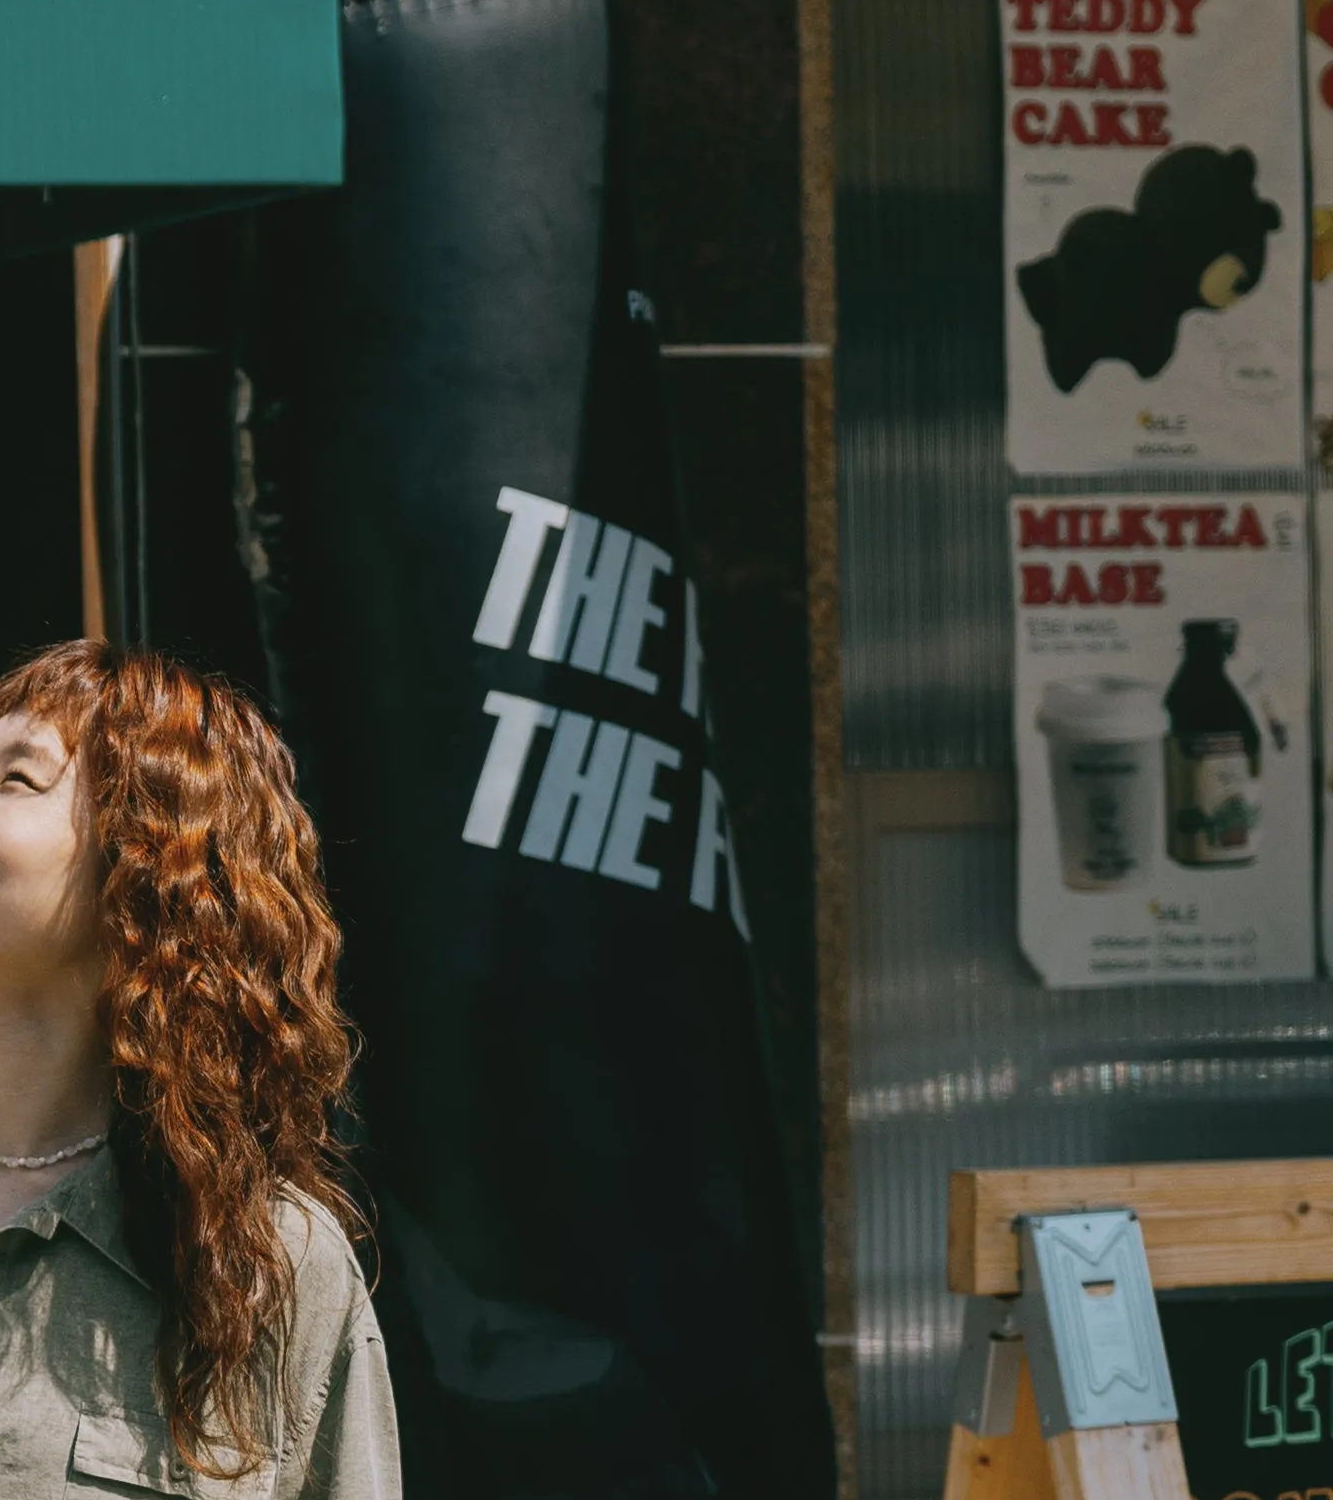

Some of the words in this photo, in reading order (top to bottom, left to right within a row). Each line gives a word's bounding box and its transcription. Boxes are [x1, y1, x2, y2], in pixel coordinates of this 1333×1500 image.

[1010, 44, 1167, 92] BEAR
[1012, 101, 1170, 146] CAKE
[472, 486, 673, 694] THE
[1020, 562, 1167, 605] BASE
[462, 690, 681, 890] THE
